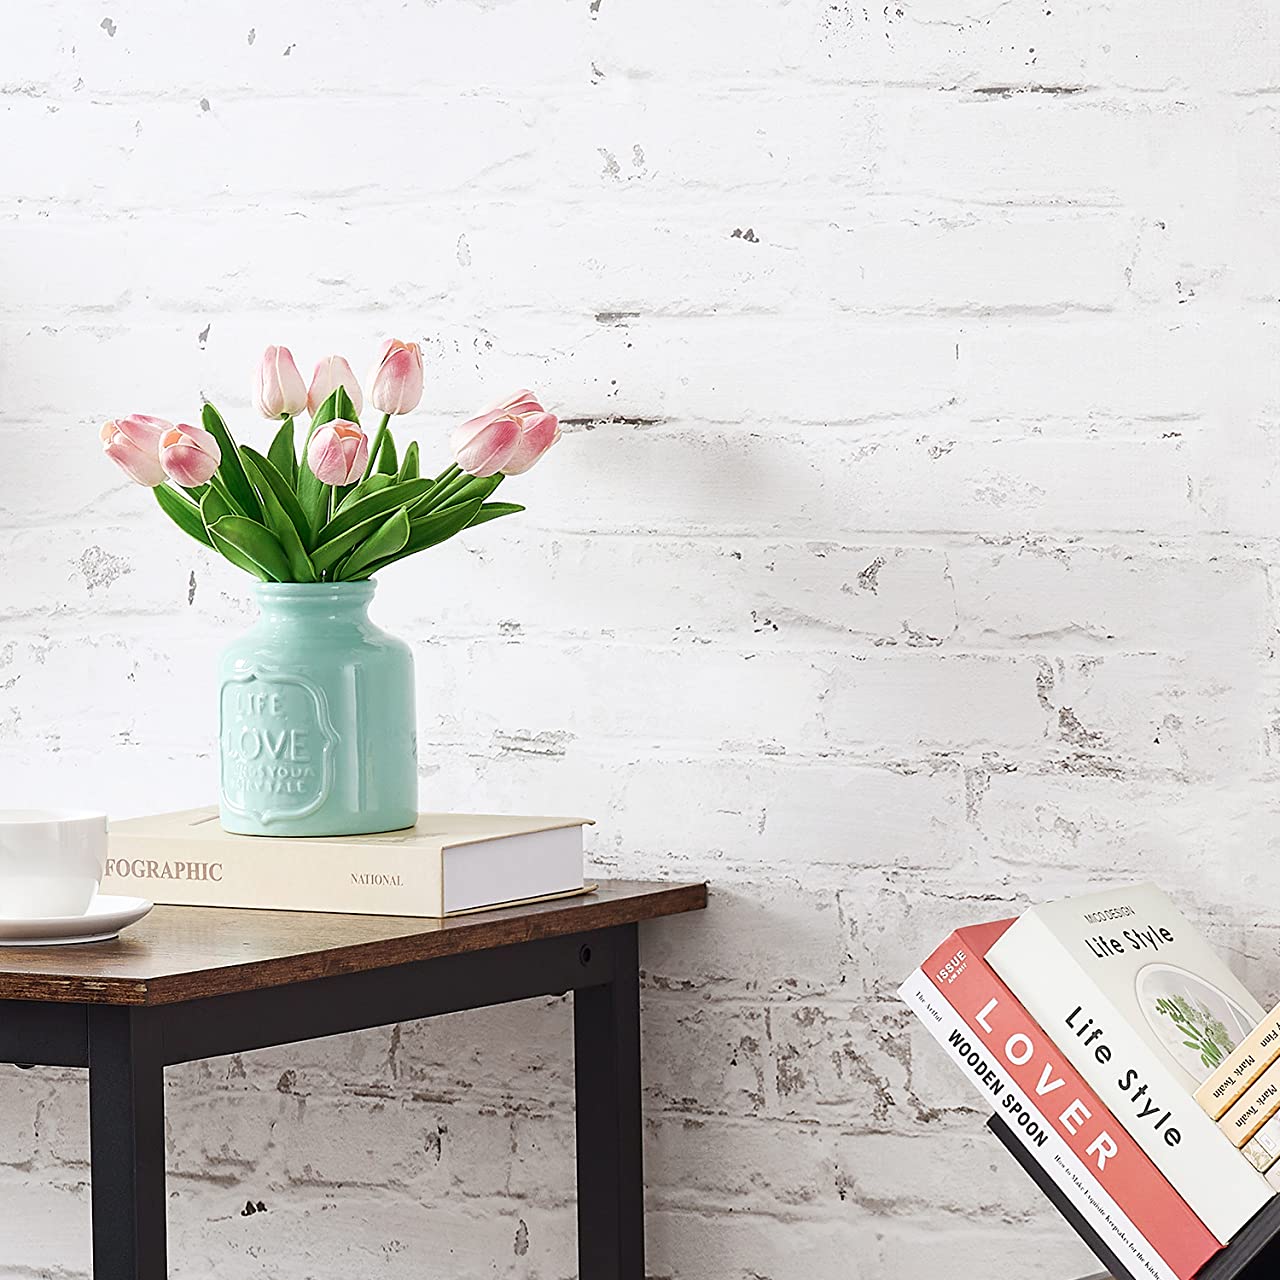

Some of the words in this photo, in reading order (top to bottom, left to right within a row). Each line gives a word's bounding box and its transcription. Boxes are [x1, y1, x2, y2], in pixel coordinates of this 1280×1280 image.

[228, 729, 311, 762] LOVE
[105, 858, 223, 882] FOGRAPHIC
[351, 873, 403, 886] NATIONAL
[1085, 936, 1125, 959] Life
[1123, 924, 1175, 951] Style
[934, 949, 967, 983] ISSUE
[1259, 1028, 1279, 1049] Finn
[1065, 1005, 1112, 1065] Life
[1118, 1069, 1183, 1148] Style
[1232, 1054, 1256, 1077] Mark
[947, 1028, 1005, 1096] WOODEN
[1000, 1093, 1049, 1148] SPOON
[975, 998, 1118, 1171] LOVER
[1212, 1075, 1237, 1099] Twain
[1254, 1083, 1278, 1107] Mark
[1234, 1104, 1259, 1129] Twain
